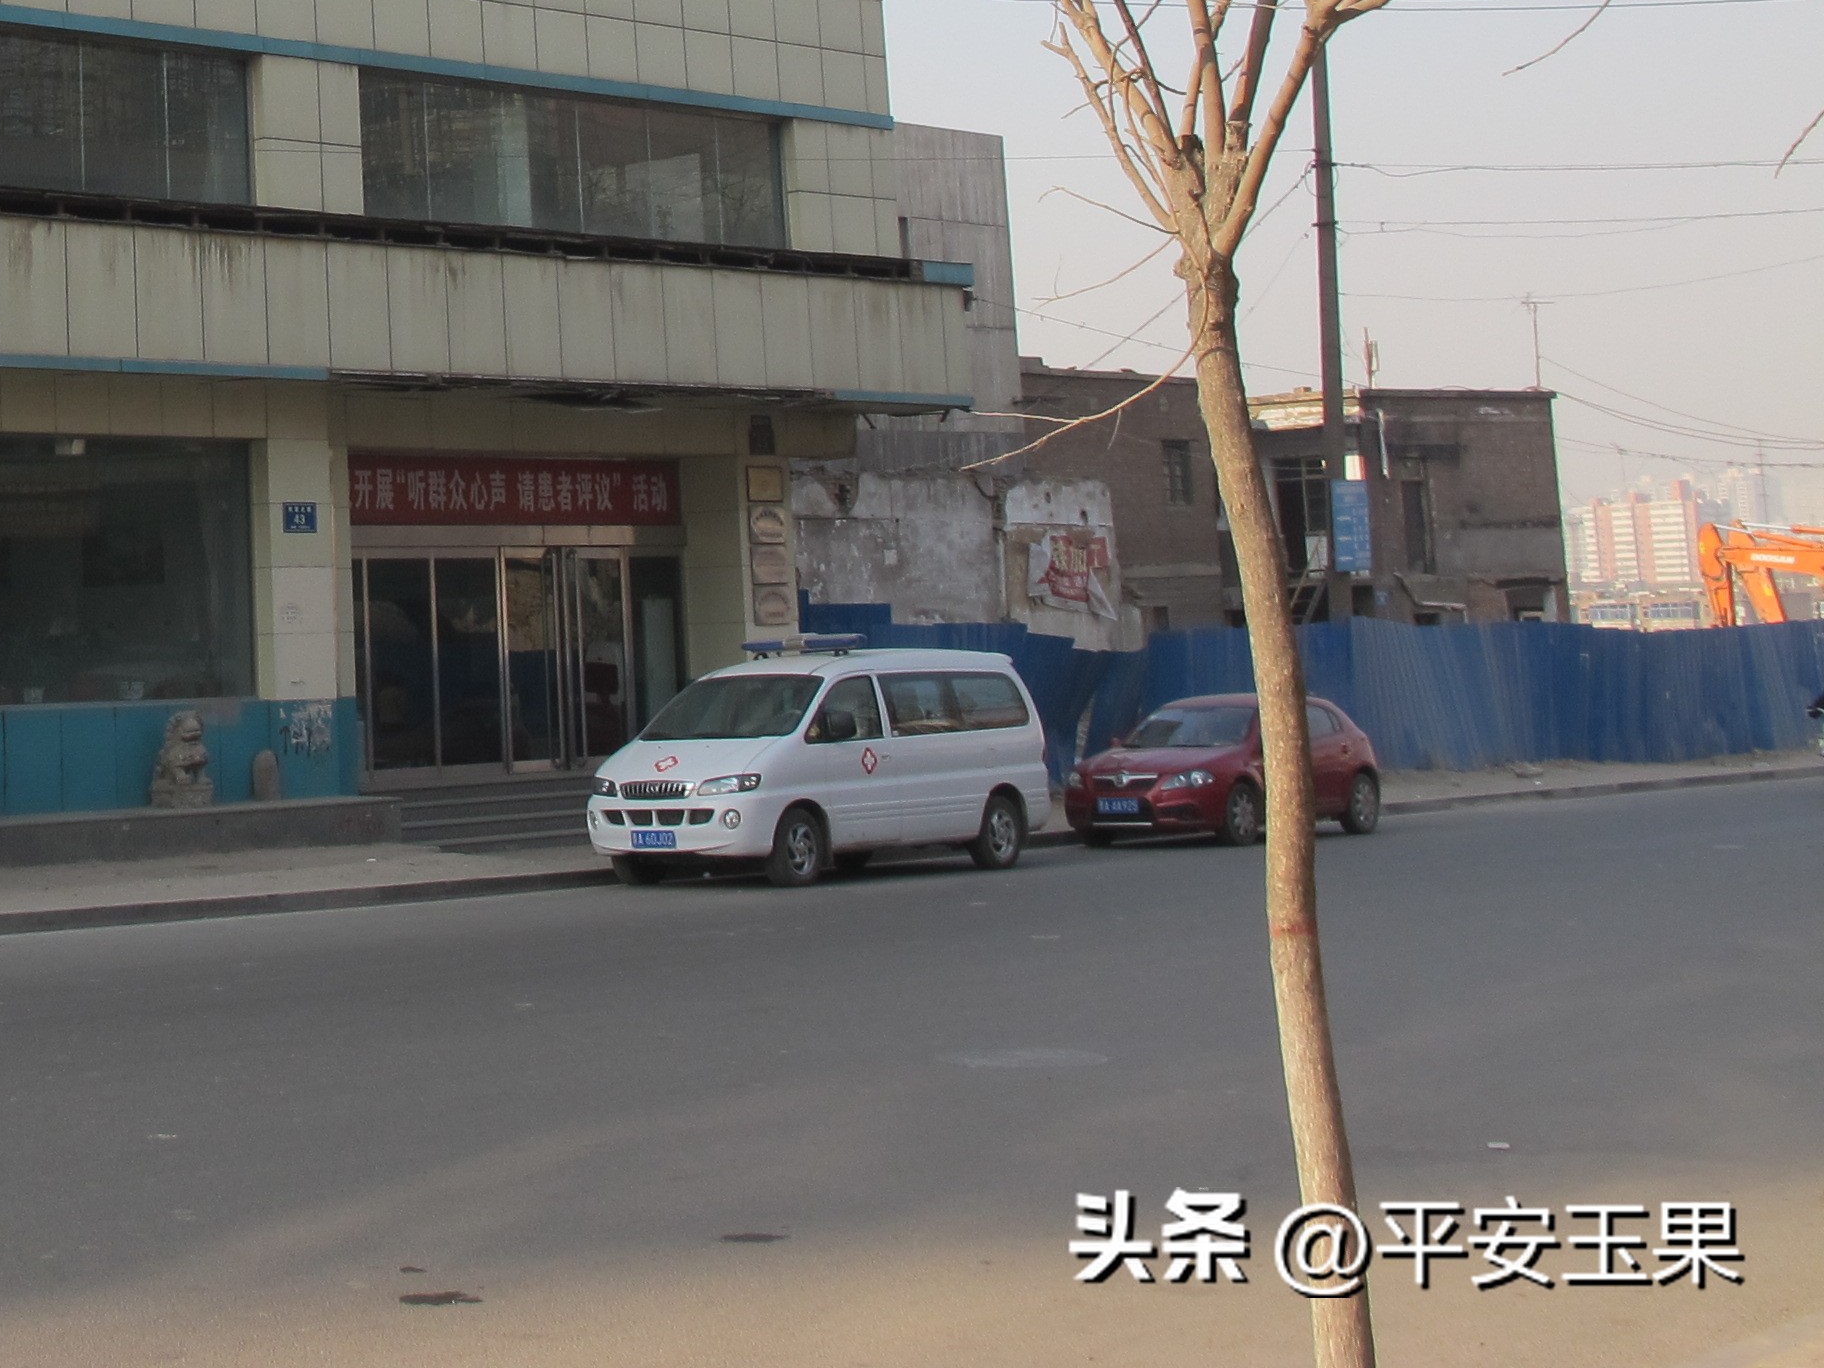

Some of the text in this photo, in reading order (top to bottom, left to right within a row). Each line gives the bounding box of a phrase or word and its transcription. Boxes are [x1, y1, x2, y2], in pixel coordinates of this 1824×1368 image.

[349, 468, 507, 512] 开展“听群众心声
[1750, 553, 1795, 564] DOOSAN
